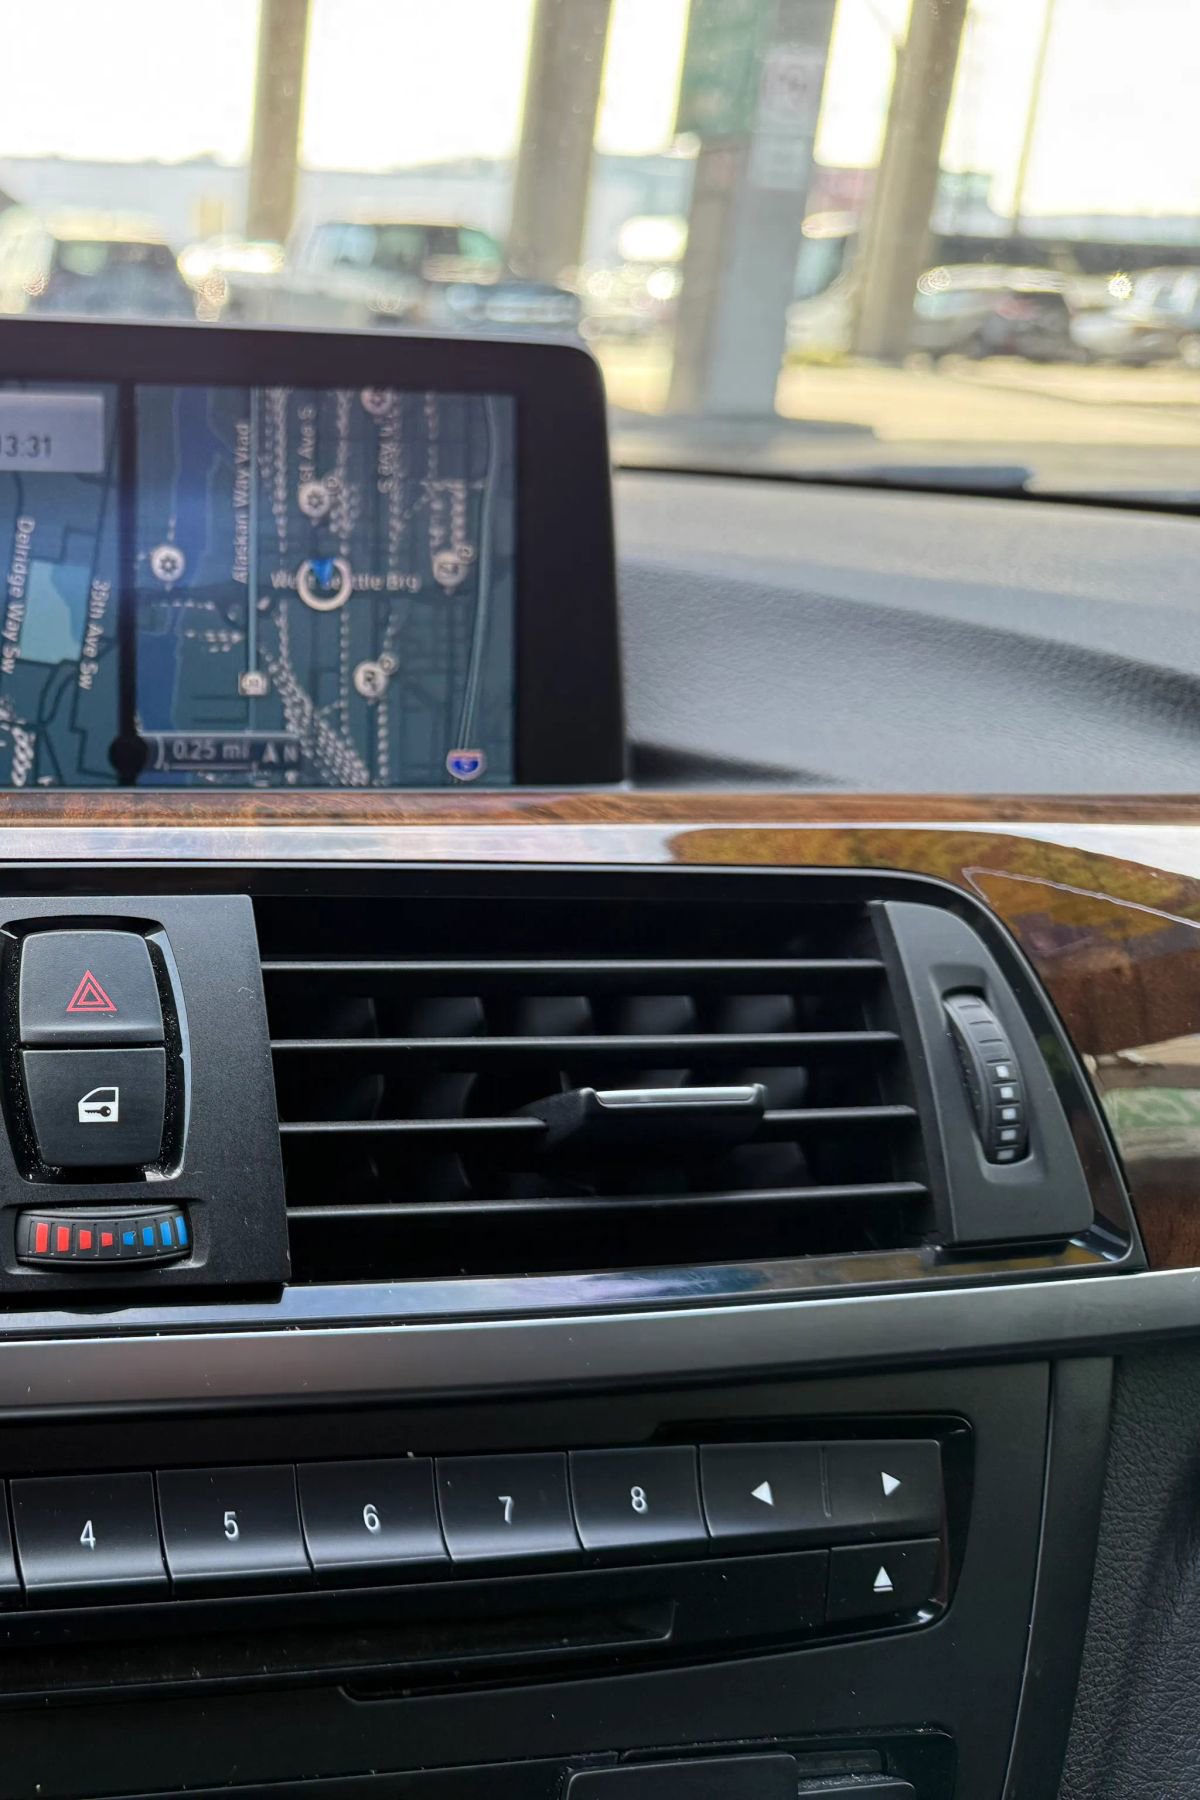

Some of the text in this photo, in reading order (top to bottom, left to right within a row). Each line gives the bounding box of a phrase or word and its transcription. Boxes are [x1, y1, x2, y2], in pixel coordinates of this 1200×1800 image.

[297, 423, 315, 460] Ave
[233, 467, 249, 508] Way
[7, 515, 36, 600] Delridge
[232, 513, 249, 584] Alaskan
[1, 601, 25, 643] Way
[82, 622, 104, 659] Ave
[172, 739, 298, 762] 0.25 mi N
[497, 1495, 514, 1524] 7
[629, 1485, 648, 1514] 8
[79, 1519, 97, 1549] 4
[223, 1510, 241, 1541] 5
[362, 1503, 381, 1534] 6
